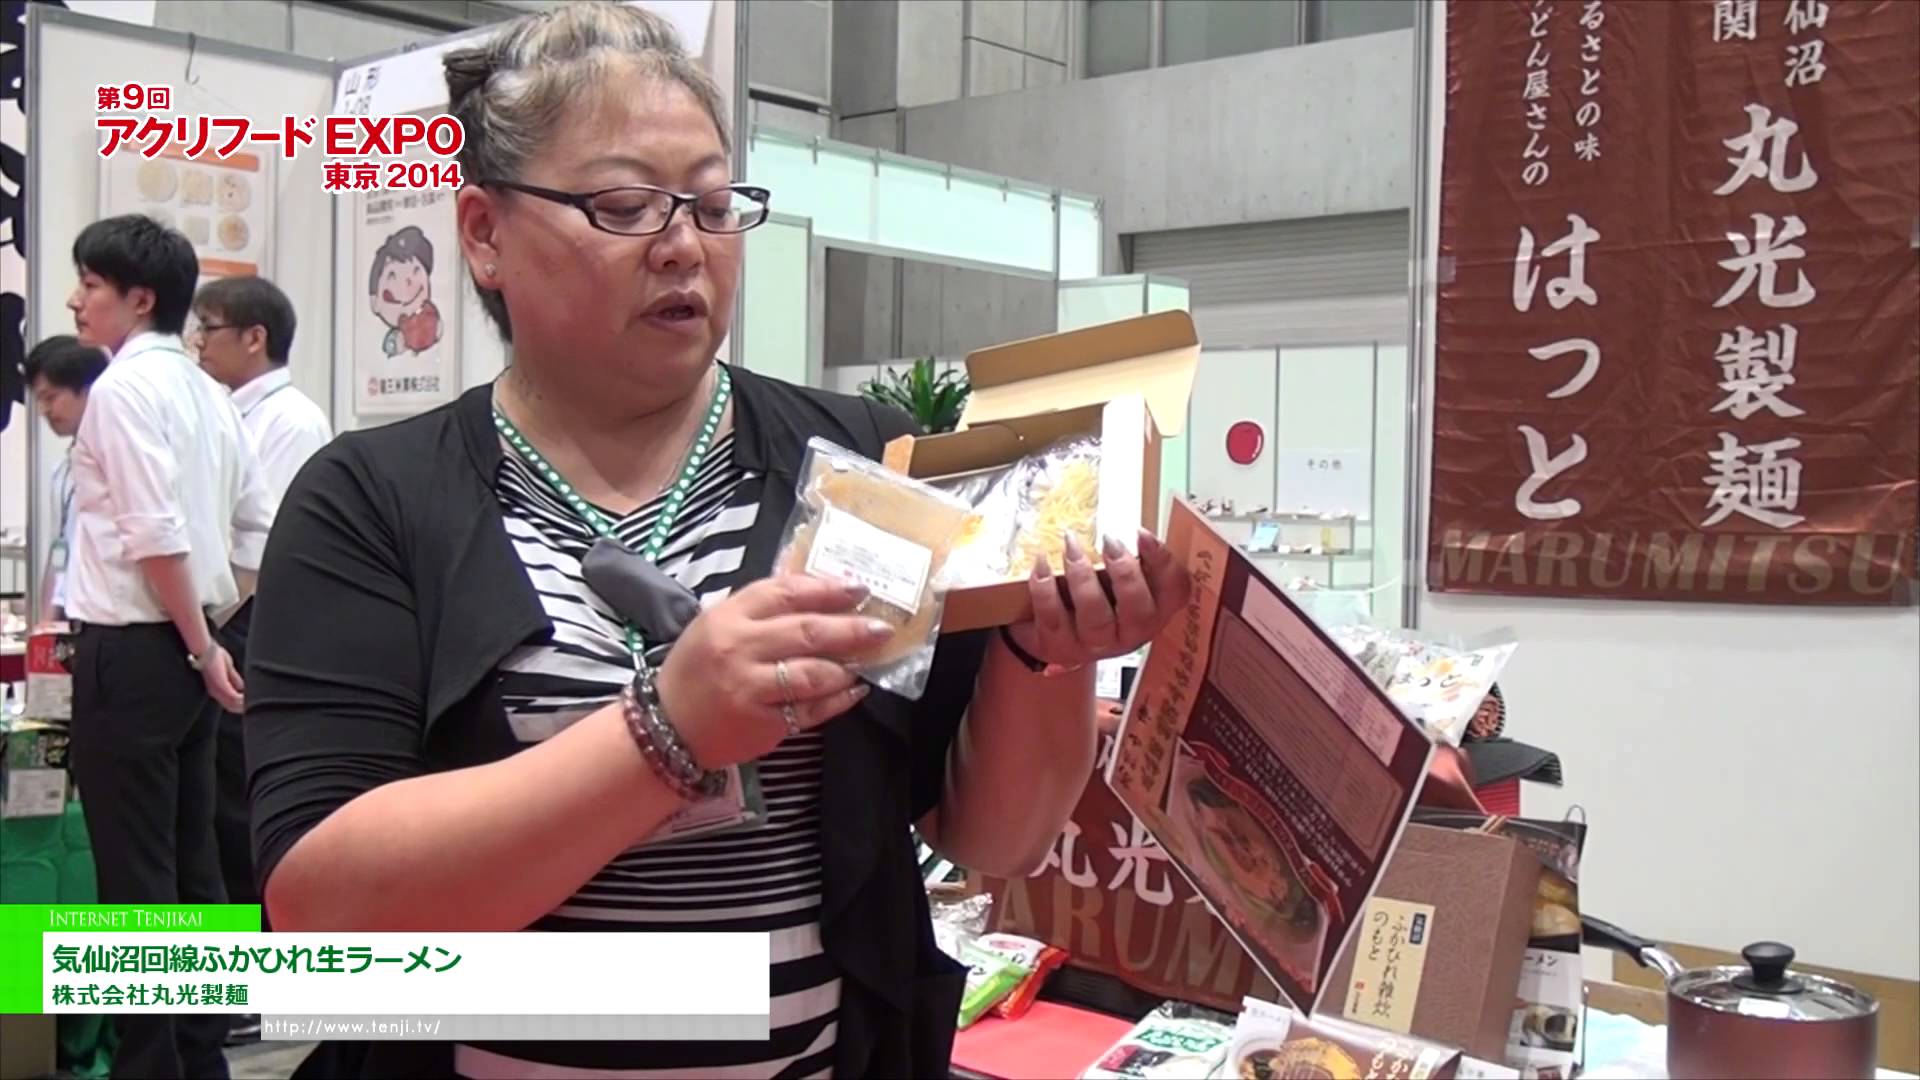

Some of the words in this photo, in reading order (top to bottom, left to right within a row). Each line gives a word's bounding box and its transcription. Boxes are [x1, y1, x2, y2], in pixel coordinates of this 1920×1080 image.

[1521, 0, 1552, 187] どん屋さんの
[1511, 213, 1602, 520] はっと
[1701, 103, 1819, 529] 丸光製麺
[1306, 458, 1343, 471] その他
[1440, 528, 1911, 596] MARUMITSU
[1368, 911, 1390, 961] のもと
[1371, 915, 1408, 1018] ふかひれ雑炊
